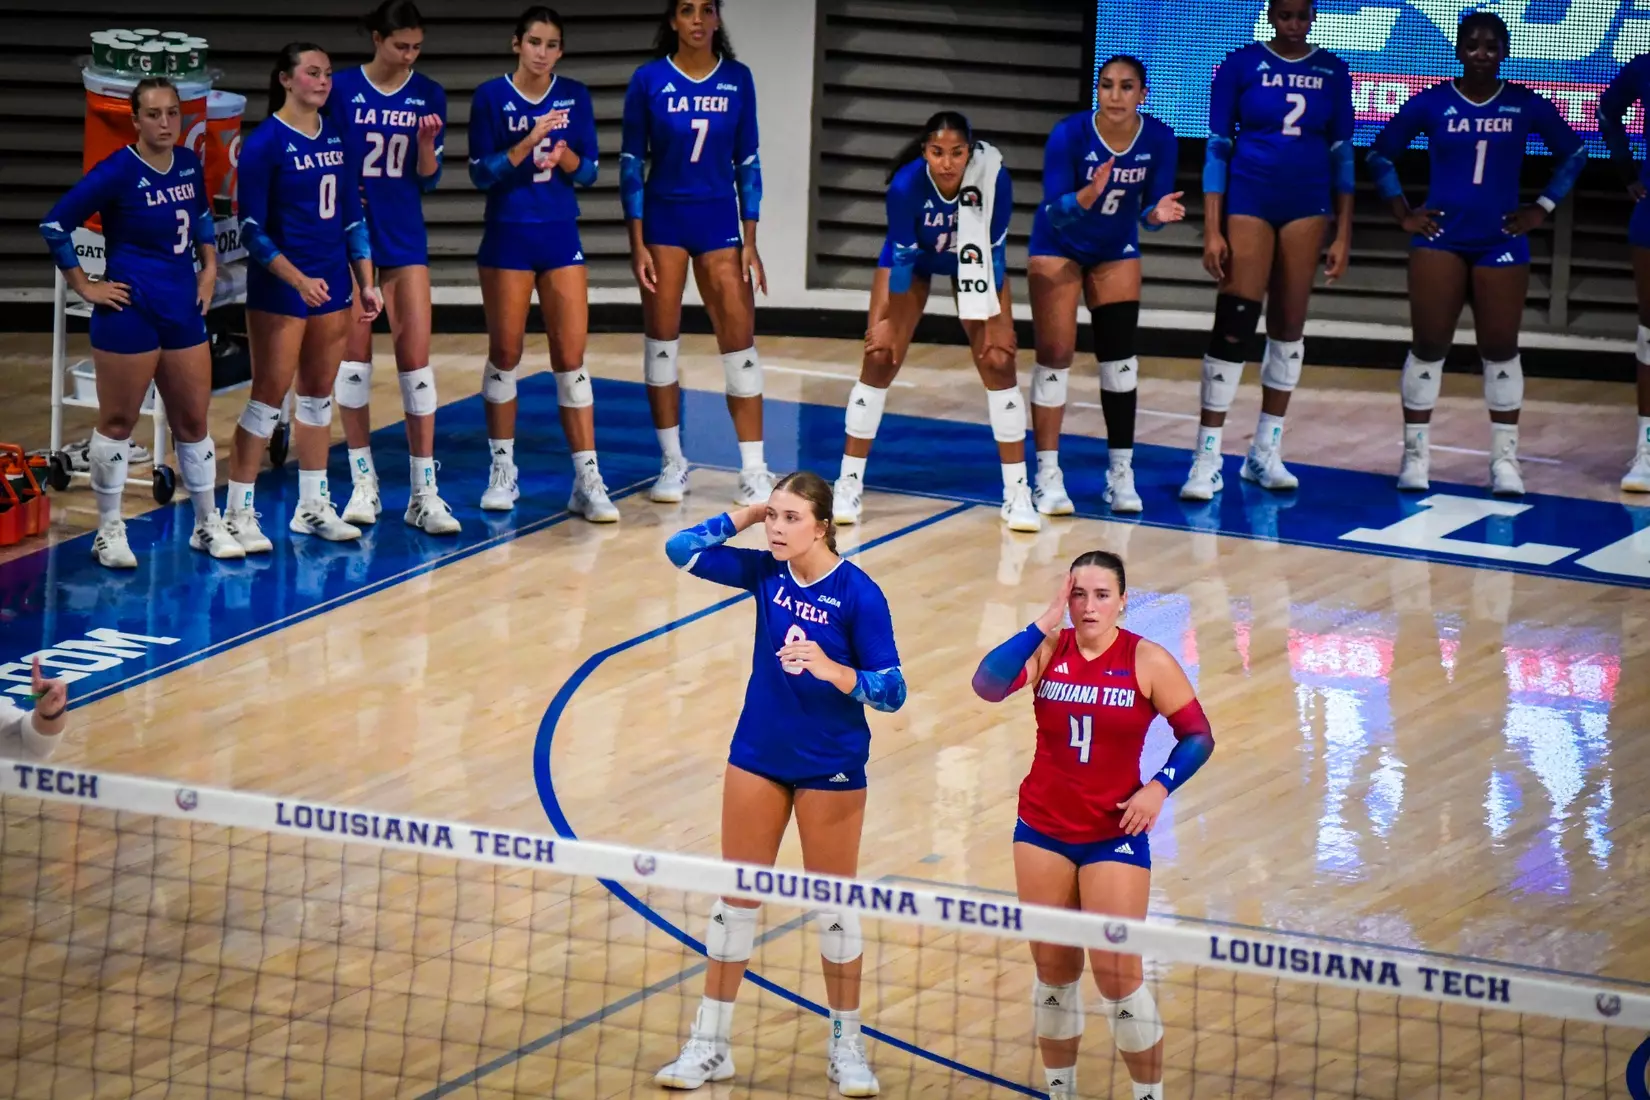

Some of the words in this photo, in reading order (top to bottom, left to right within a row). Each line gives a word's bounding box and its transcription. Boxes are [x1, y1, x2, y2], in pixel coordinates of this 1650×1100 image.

[1262, 73, 1284, 87] LA
[1288, 74, 1323, 89] TECH
[354, 108, 376, 124] LA
[382, 109, 416, 127] TECH
[668, 96, 688, 112] LA
[693, 96, 728, 112] TECH
[1282, 93, 1306, 136] 2
[508, 115, 528, 132] LA
[690, 118, 709, 162] 7
[1448, 118, 1470, 132] LA
[1474, 118, 1512, 132] TECH
[294, 154, 315, 170] LA
[315, 151, 344, 168] TECH
[362, 132, 409, 178] 20
[1472, 140, 1488, 184] 1
[1112, 167, 1146, 183] TECH
[146, 191, 168, 206] LA
[167, 183, 194, 202] TECH
[319, 174, 336, 220] 0
[1100, 189, 1126, 216] 6
[174, 208, 190, 254] 3
[924, 212, 944, 226] LA
[772, 586, 792, 611] LA
[794, 600, 829, 624] TECH
[1036, 679, 1098, 704] LOUISIANA
[1102, 686, 1136, 708] TECH
[1069, 714, 1092, 764] 4
[13, 764, 99, 799] TECH
[275, 802, 454, 850] LOUISIANA
[470, 829, 556, 864] TECH
[736, 868, 920, 917] LOUISIANA
[936, 896, 1023, 932] TECH
[1210, 936, 1400, 987] LOUISIANA
[1418, 966, 1510, 1004] TECH
